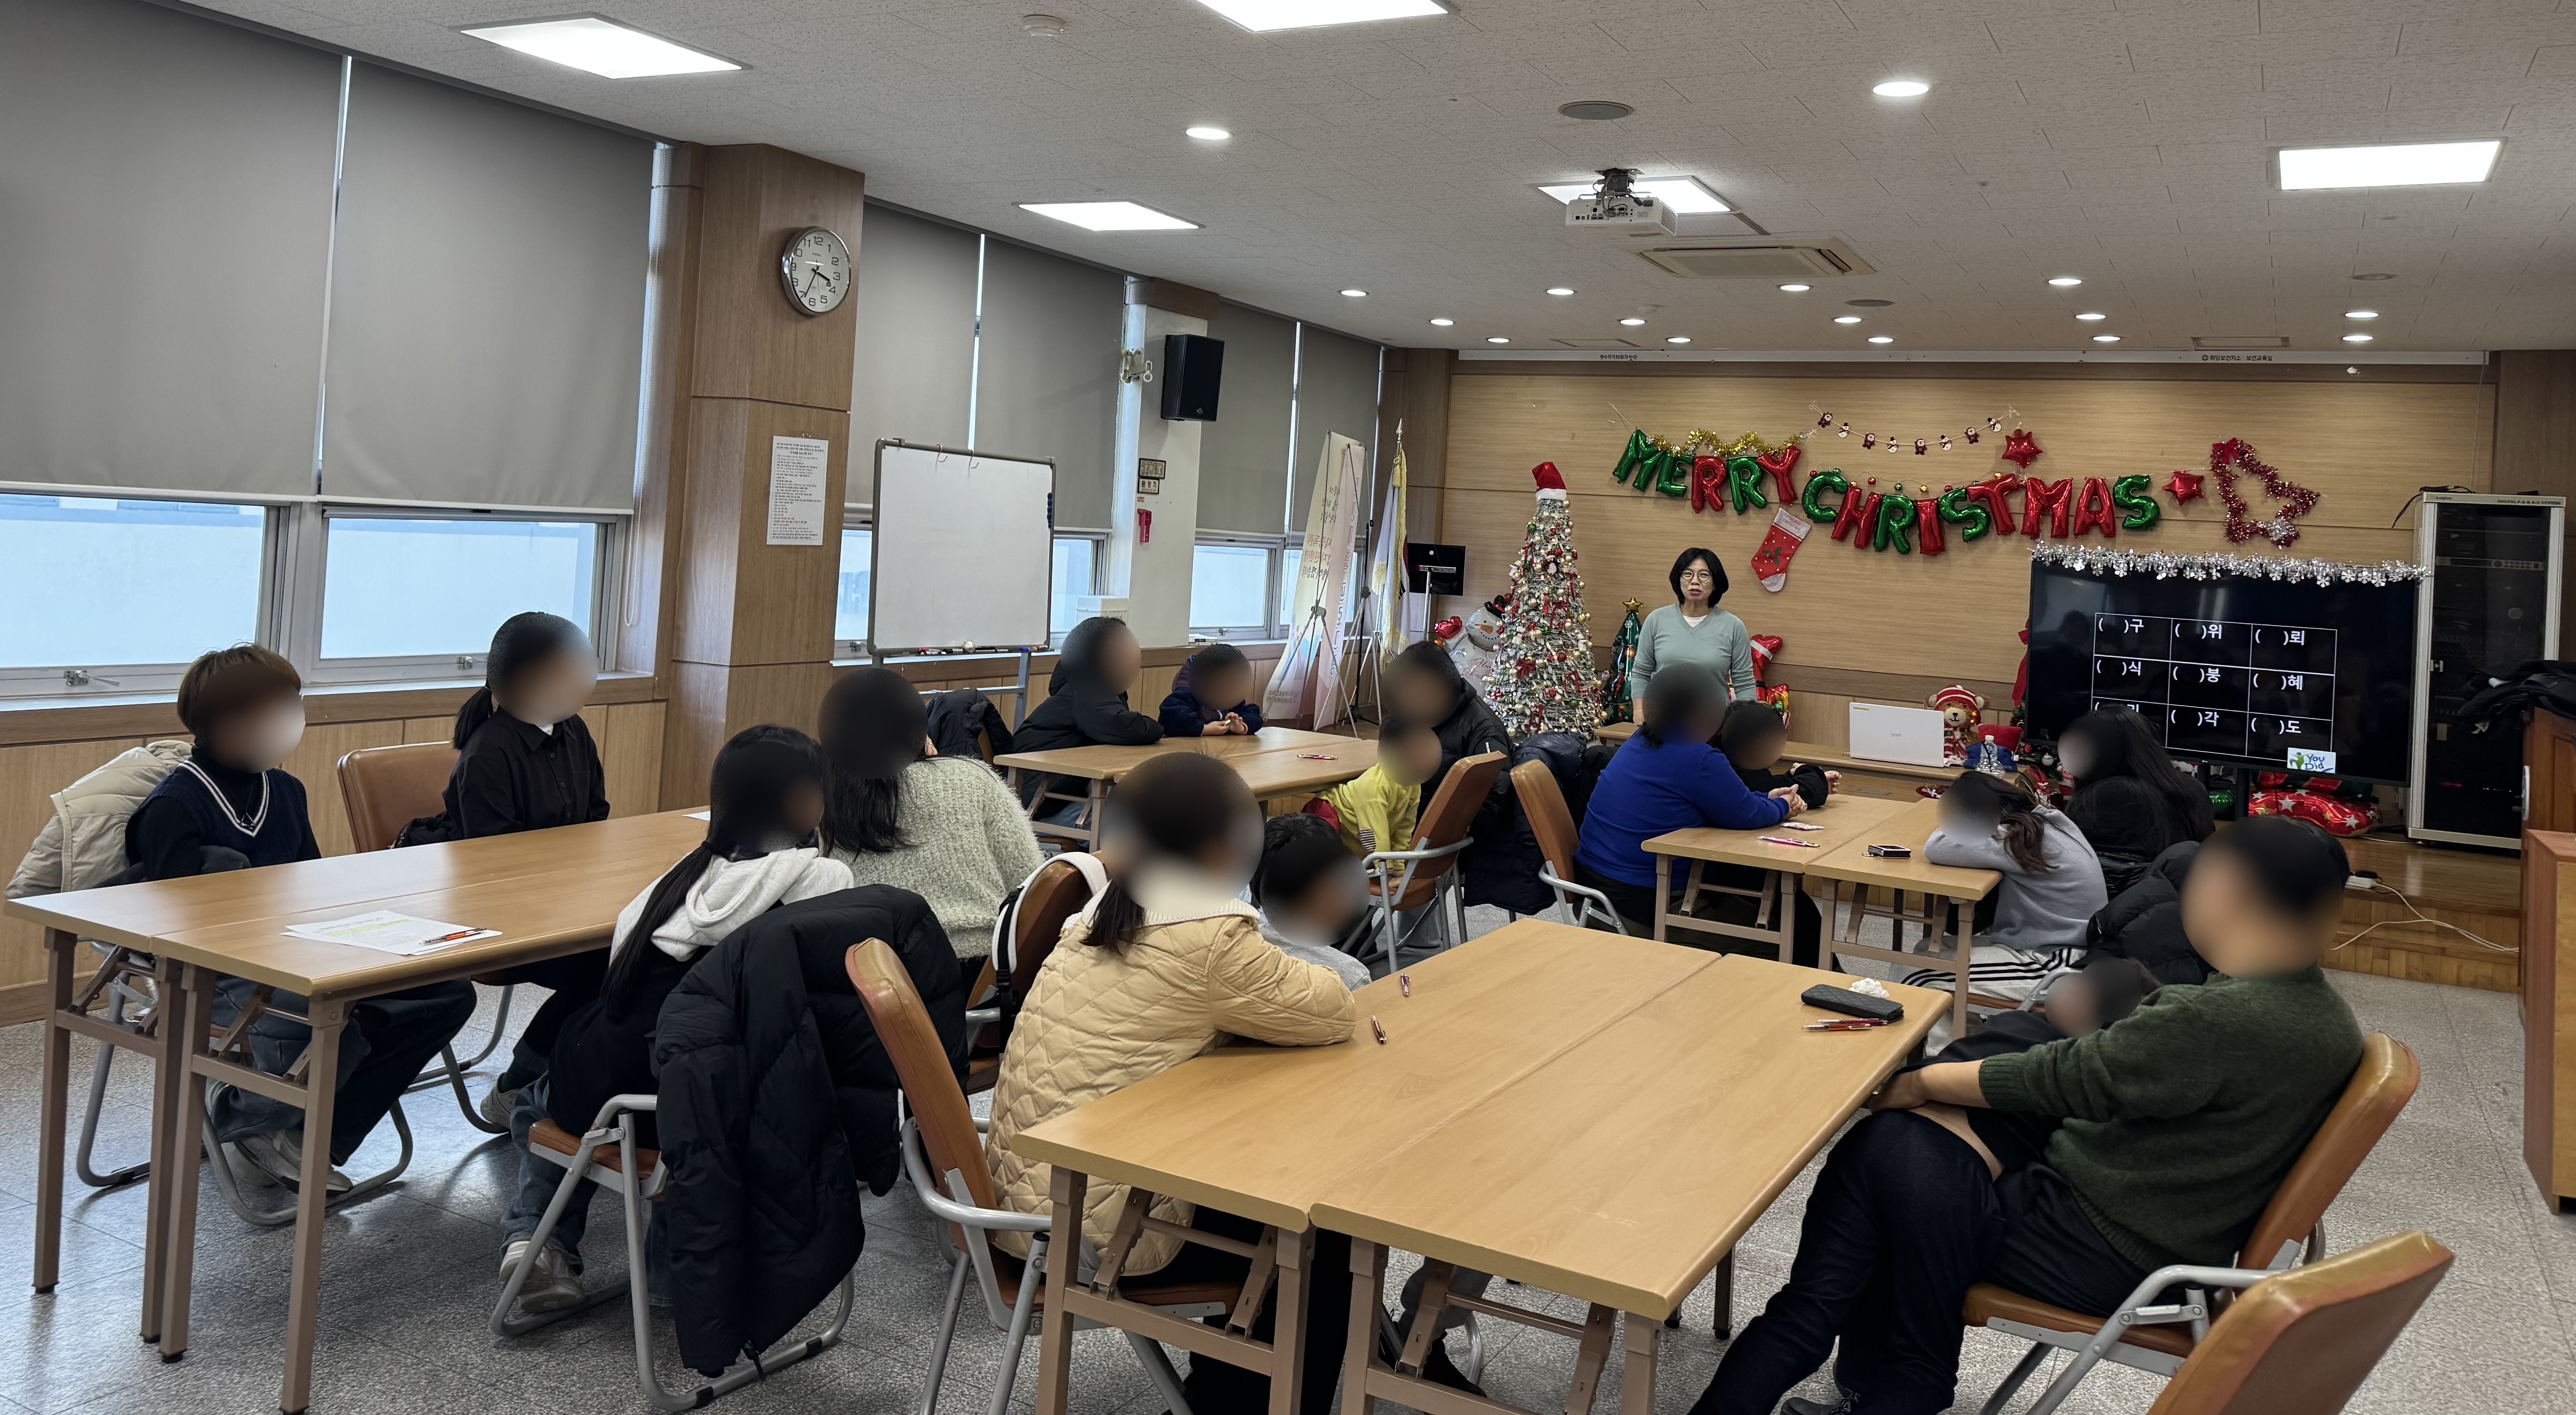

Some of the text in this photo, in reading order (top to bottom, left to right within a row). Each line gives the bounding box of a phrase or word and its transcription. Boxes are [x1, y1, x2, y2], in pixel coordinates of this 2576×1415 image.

[804, 238, 810, 248] 11
[813, 236, 823, 246] 12
[796, 248, 803, 257] 0
[832, 257, 839, 266] 2
[833, 272, 841, 281] 3
[809, 298, 816, 306] 6
[820, 295, 827, 304] 5
[1612, 428, 1801, 516] MERRY
[1802, 471, 2160, 556] CHRISTMAS
[2307, 754, 2325, 763] You
